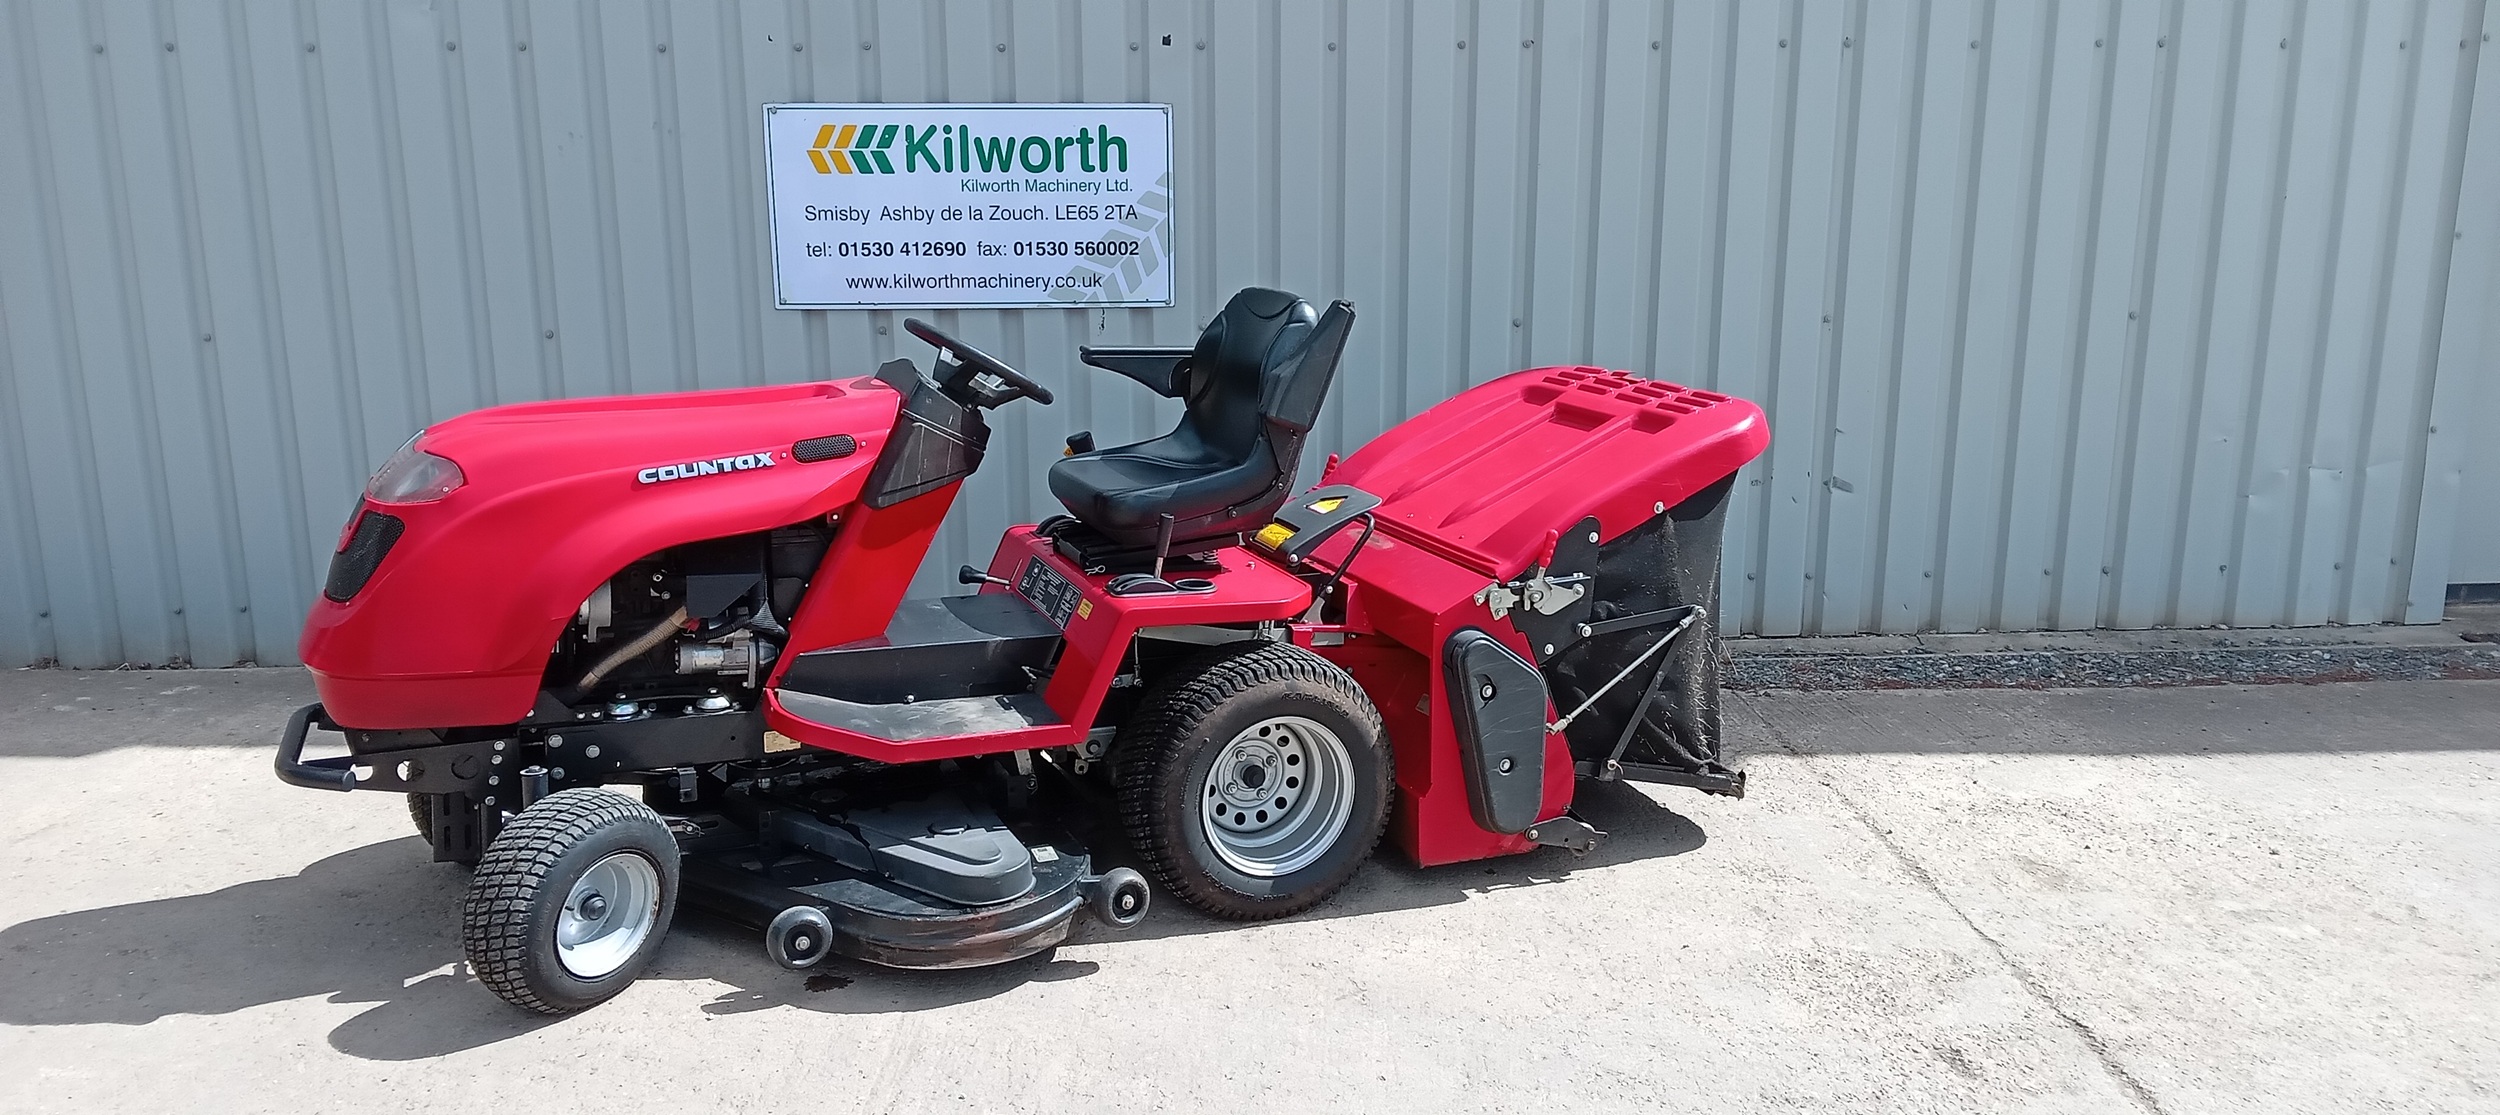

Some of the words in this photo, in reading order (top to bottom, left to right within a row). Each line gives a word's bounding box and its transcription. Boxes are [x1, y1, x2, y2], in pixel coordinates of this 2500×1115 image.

[904, 124, 1128, 174] Kilworth
[960, 178, 1020, 193] Kilworth
[1024, 178, 1102, 196] Machinery
[1106, 178, 1133, 193] Ltd.
[804, 204, 871, 226] Smisby
[879, 205, 935, 226] Ashby
[940, 204, 963, 222] de
[968, 204, 984, 221] la
[988, 204, 1049, 221] Zouch.
[1055, 204, 1099, 221] LE65
[1105, 205, 1138, 221] 2TA
[805, 241, 833, 258] tel:
[838, 241, 894, 258] 01530
[899, 241, 967, 257] 412690
[976, 240, 1007, 257] fax:
[1013, 240, 1069, 257] 01530
[1073, 241, 1140, 257] 560002
[845, 273, 1103, 290] www.kilworthmachinery.co.uk
